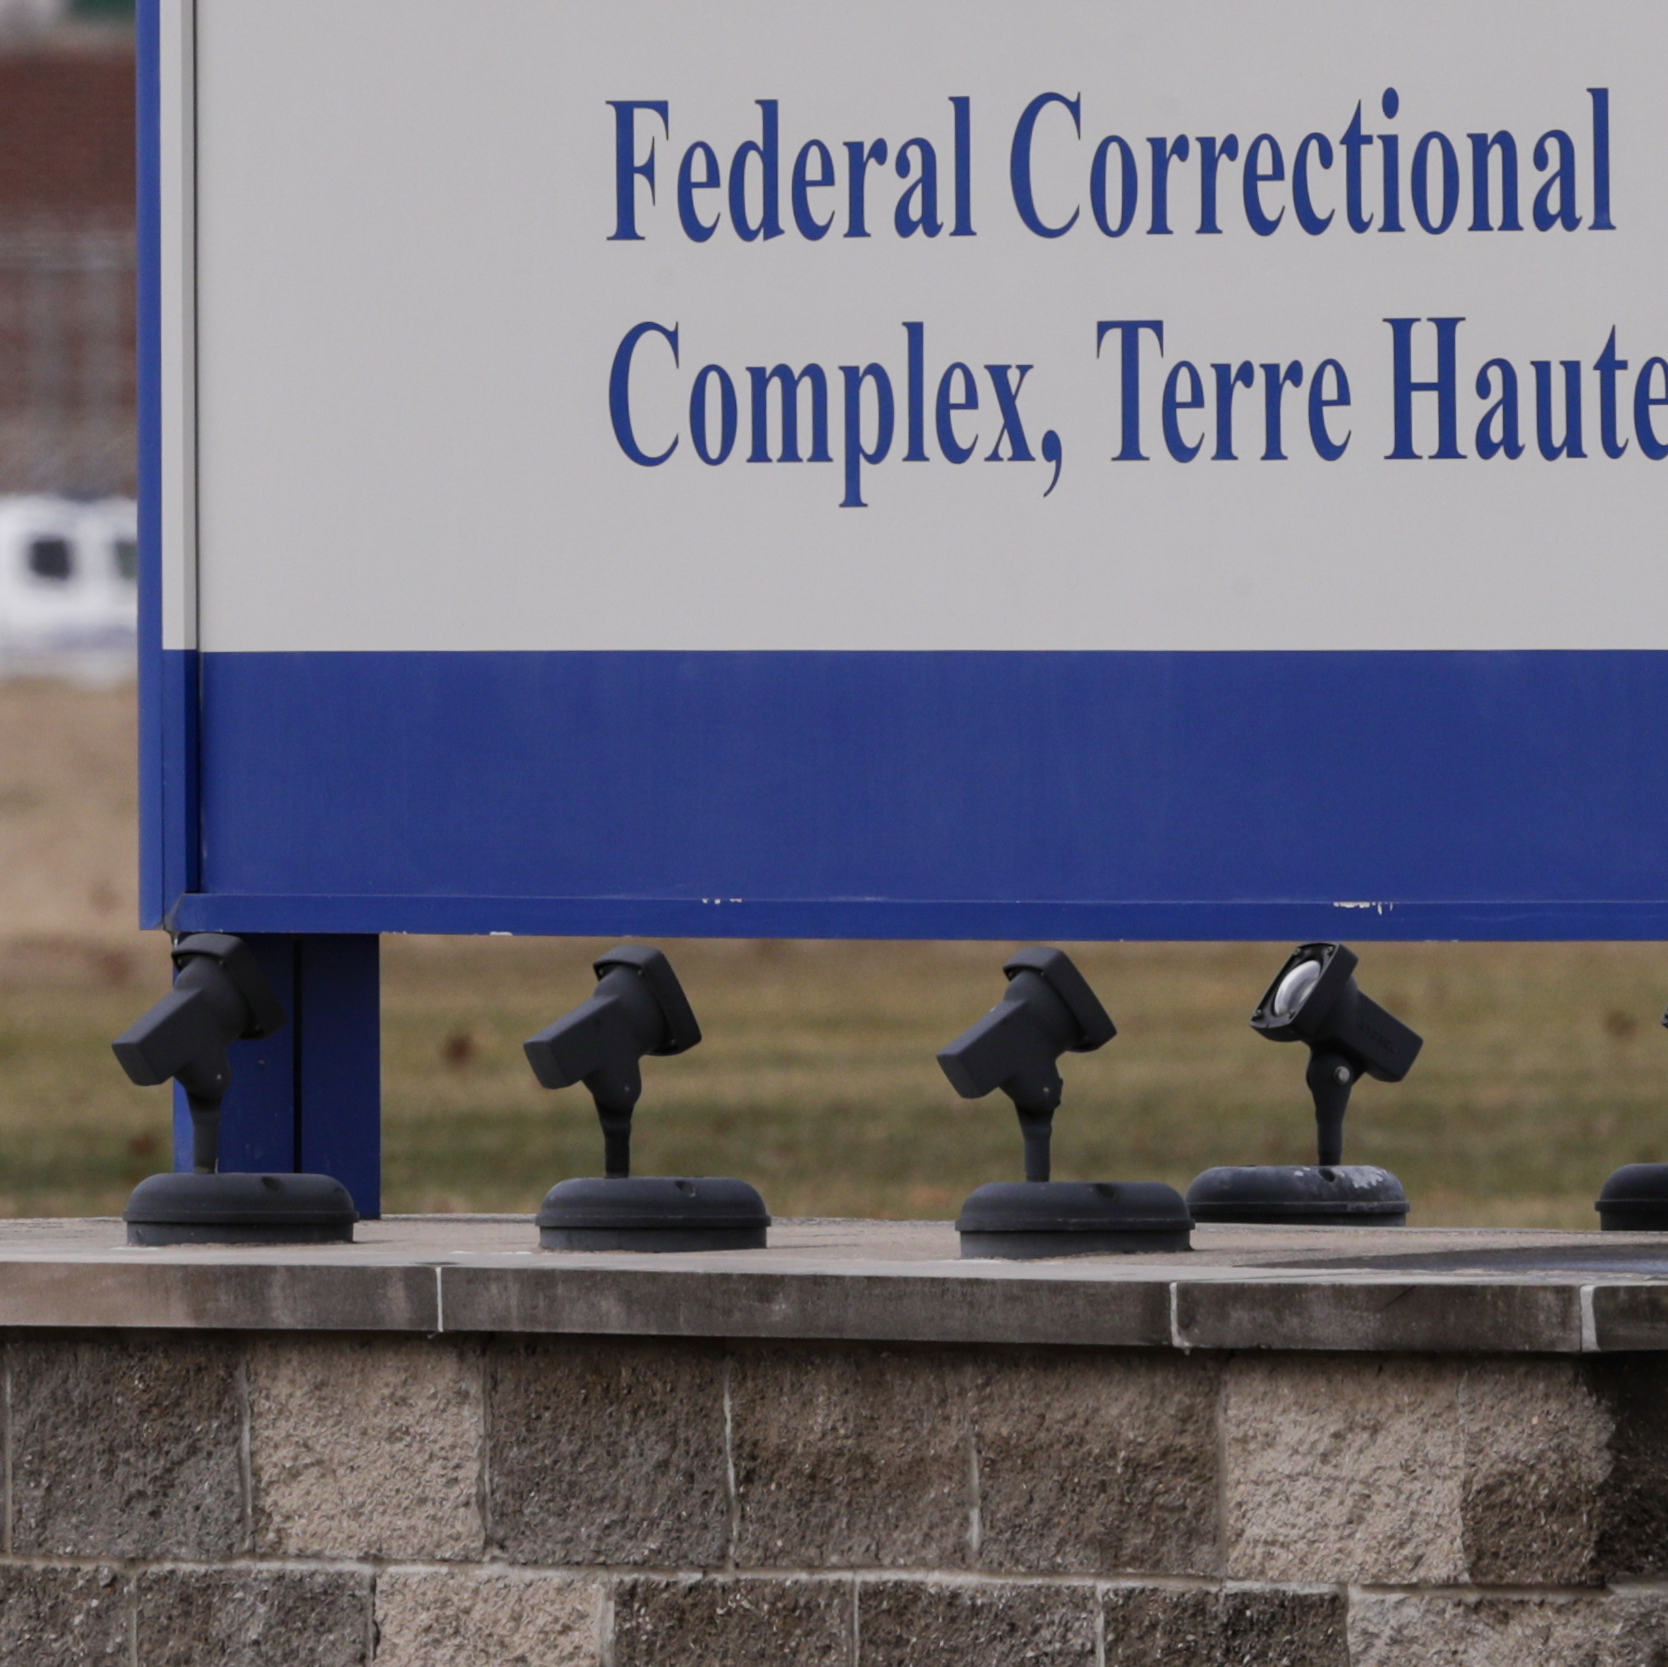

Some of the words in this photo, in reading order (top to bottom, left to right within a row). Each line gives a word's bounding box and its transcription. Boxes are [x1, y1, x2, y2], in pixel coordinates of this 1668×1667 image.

[604, 95, 978, 244] Federal
[1009, 86, 1617, 240] Correctional
[608, 320, 1063, 509] Complex,
[1095, 319, 1352, 464] Terre
